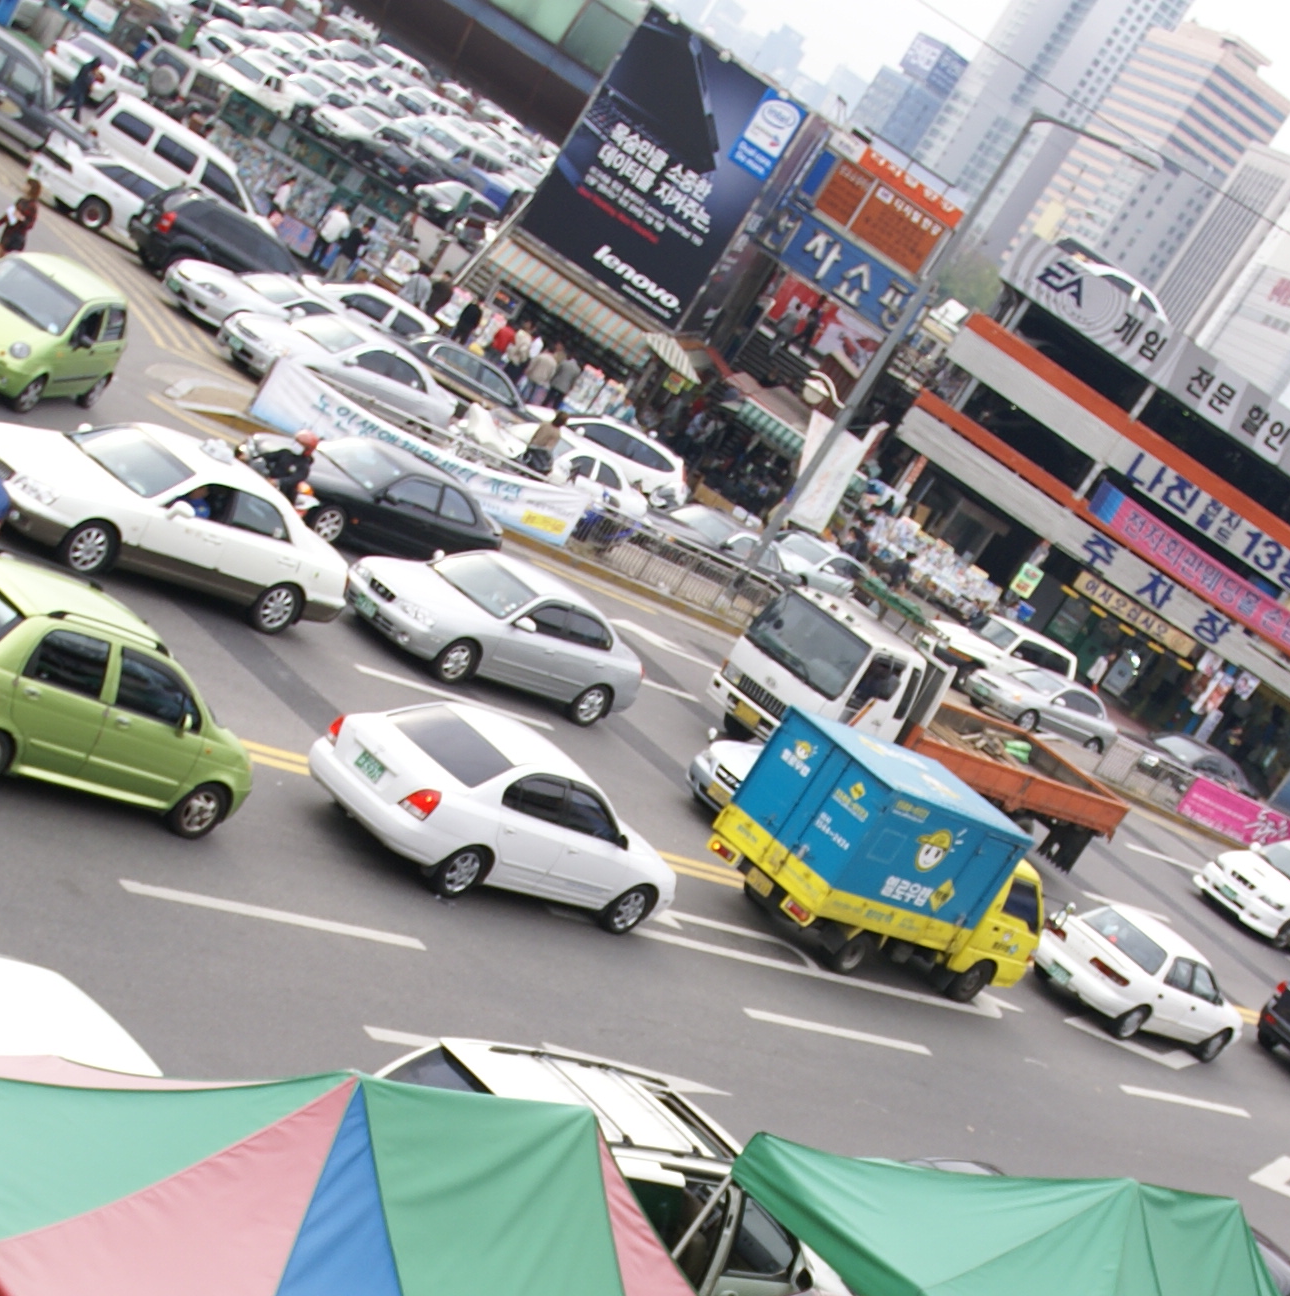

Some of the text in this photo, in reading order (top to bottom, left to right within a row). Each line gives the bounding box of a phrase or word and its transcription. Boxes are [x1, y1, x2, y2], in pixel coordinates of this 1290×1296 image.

[597, 143, 657, 193] 데이터를
[592, 244, 679, 311] lenovo
[1037, 261, 1086, 308] EA
[1113, 312, 1168, 363] 게임
[1185, 364, 1237, 415] 전문
[1124, 452, 1202, 516] 나진
[1081, 531, 1231, 646] 주차장
[1120, 510, 1263, 618] 전자회관웨딩홀
[1083, 578, 1168, 640] 어서오십시오
